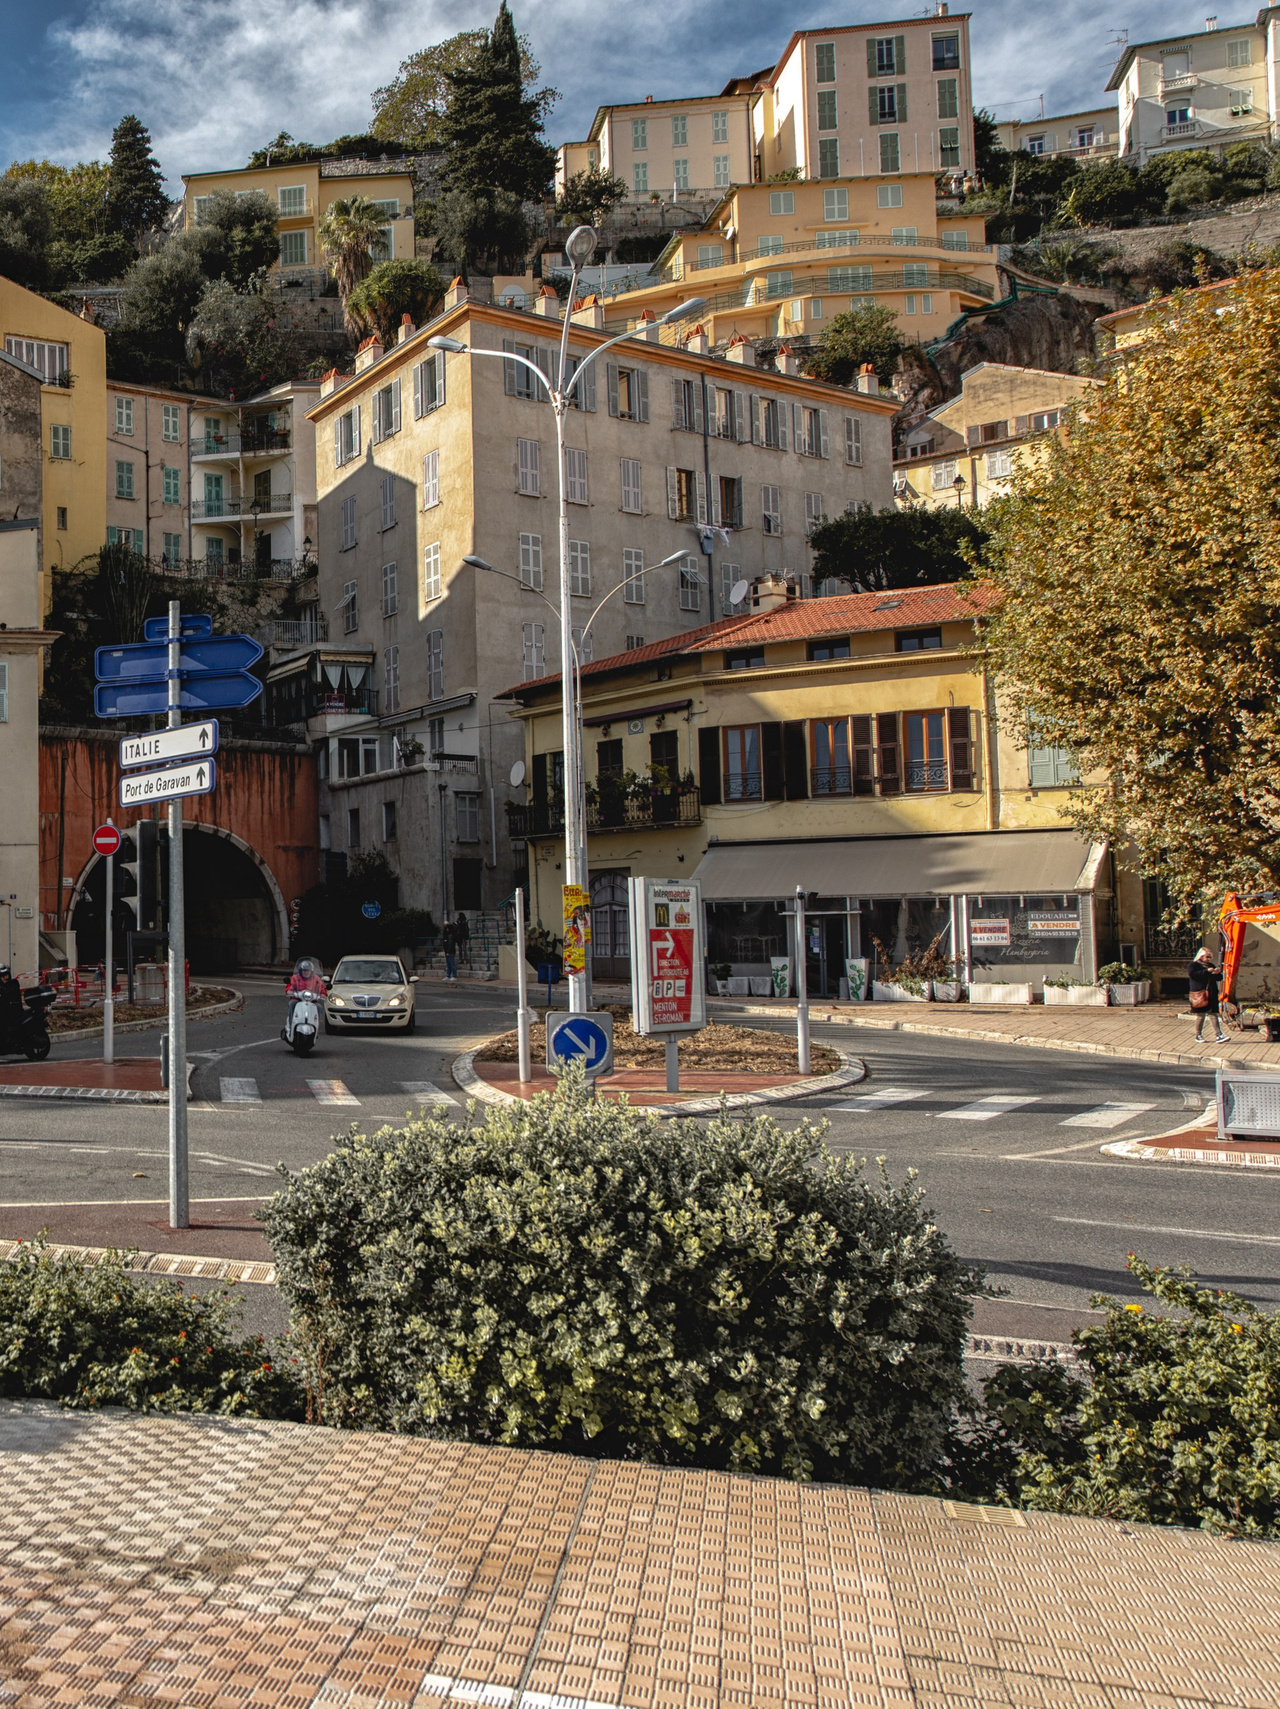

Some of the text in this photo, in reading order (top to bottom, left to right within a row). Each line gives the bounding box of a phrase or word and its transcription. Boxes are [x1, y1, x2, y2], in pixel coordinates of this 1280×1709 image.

[125, 740, 160, 759] ITALIE
[125, 775, 190, 797] Port de Garavan
[654, 888, 690, 898] Intermarché
[1000, 947, 1050, 958] Hamburgeria
[653, 1002, 677, 1011] MENTON
[654, 1012, 683, 1023] ST-ROMAN
